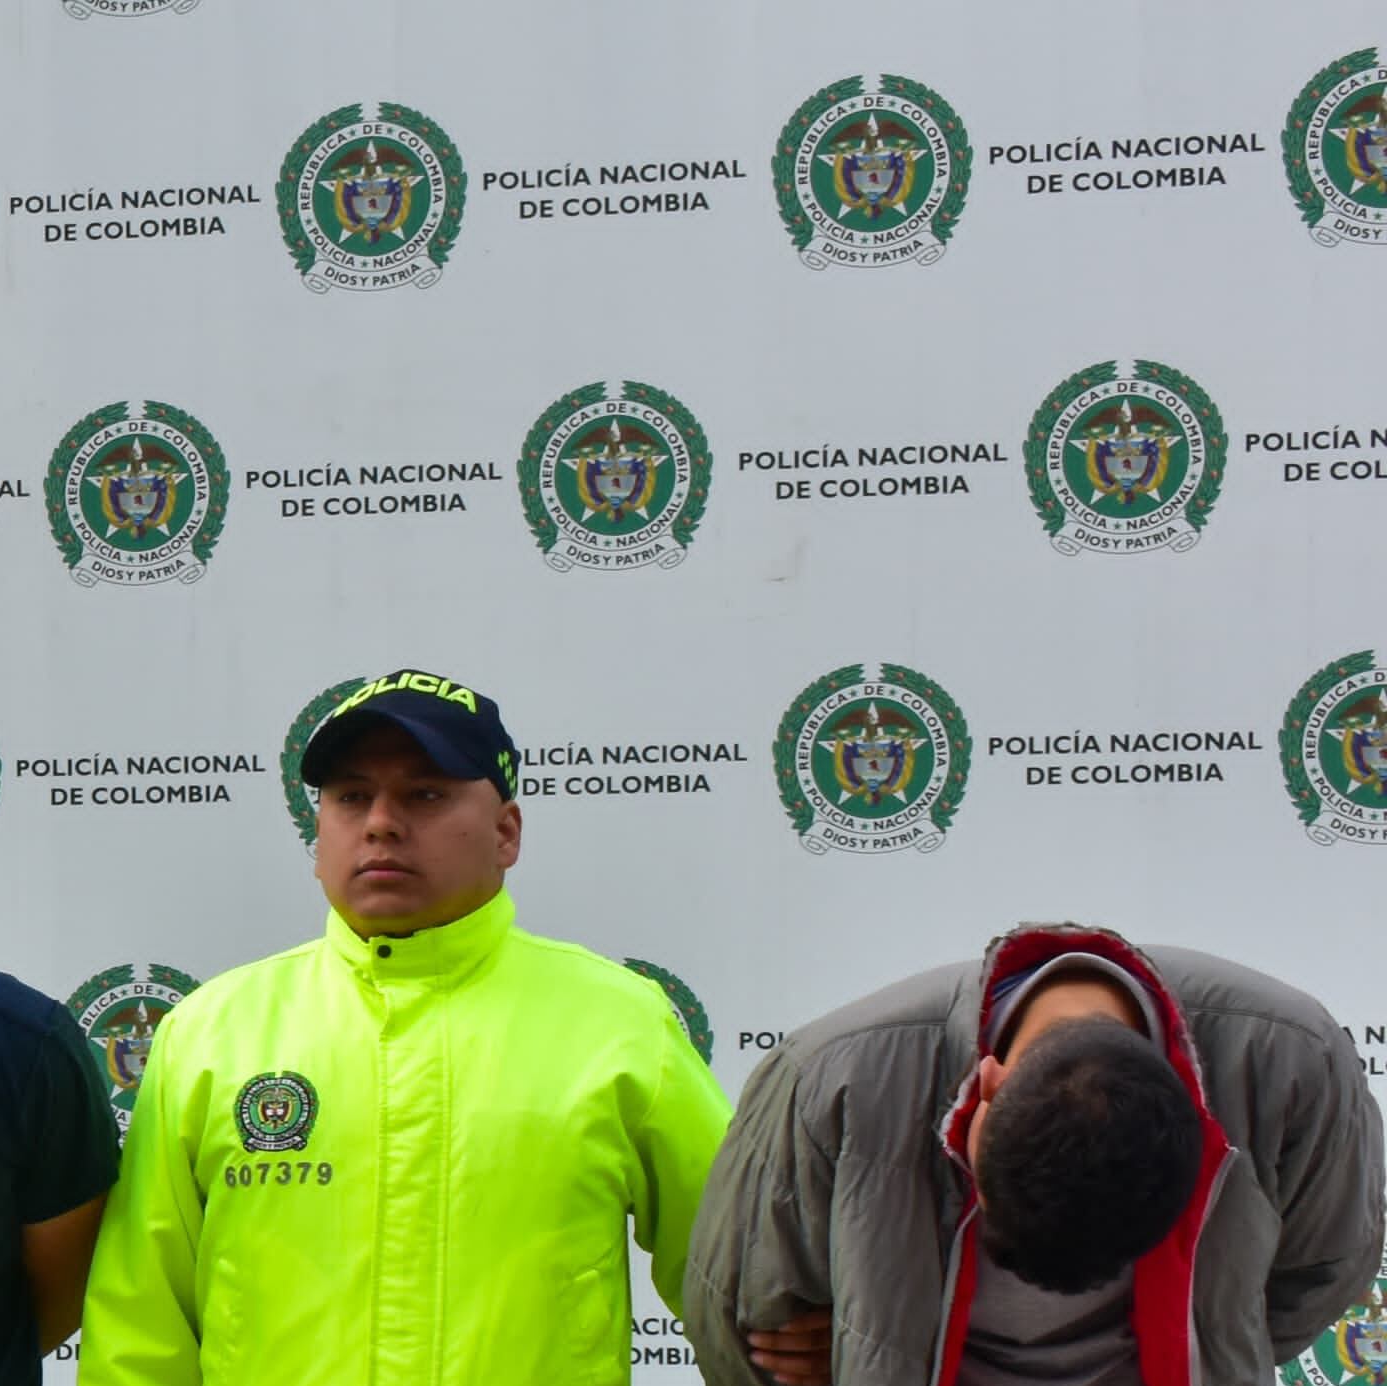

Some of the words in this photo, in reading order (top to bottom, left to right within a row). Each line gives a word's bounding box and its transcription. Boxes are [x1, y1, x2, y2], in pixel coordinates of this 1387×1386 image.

[863, 96, 885, 108] DE
[900, 103, 948, 179] COLOMBIA
[989, 136, 1103, 165] POLICÍA
[1111, 132, 1266, 159] NACIONAL
[482, 162, 592, 191] POLICÍA
[599, 159, 747, 185] NACIONAL
[1027, 173, 1063, 195] DE
[1072, 165, 1227, 192] COLOMBIA
[10, 187, 114, 215] POLICÍA
[121, 184, 261, 209] NACIONAL
[519, 199, 554, 220] DE
[562, 191, 710, 217] COLOMBIA
[44, 223, 78, 243] DE
[85, 215, 226, 241] COLOMBIA
[873, 196, 940, 244] NACIONAL
[872, 239, 924, 263] PATRIA
[1245, 424, 1362, 453] POLICÍA
[738, 443, 850, 471] POLICÍA
[858, 442, 1008, 467] NACIONAL
[246, 462, 352, 489] POLICÍA
[359, 461, 503, 485] NACIONAL
[1283, 462, 1321, 482] DE
[775, 480, 812, 501] DE
[819, 474, 970, 499] COLOMBIA
[281, 498, 316, 518] DE
[322, 493, 467, 516] COLOMBIA
[523, 741, 594, 767] LICÍA
[602, 743, 748, 765] NACIONAL
[988, 729, 1102, 756] POLICÍA
[1110, 731, 1263, 753] NACIONAL
[16, 752, 119, 777] POLICÍA
[126, 754, 266, 776] NACIONAL
[1026, 766, 1062, 786] DE
[1070, 762, 1224, 785] COLOMBIA
[50, 787, 84, 806] DE
[91, 784, 231, 805] COLOMBIA
[522, 777, 556, 796] DE
[564, 774, 711, 796] COLOMBIA
[224, 1161, 333, 1189] 607379
